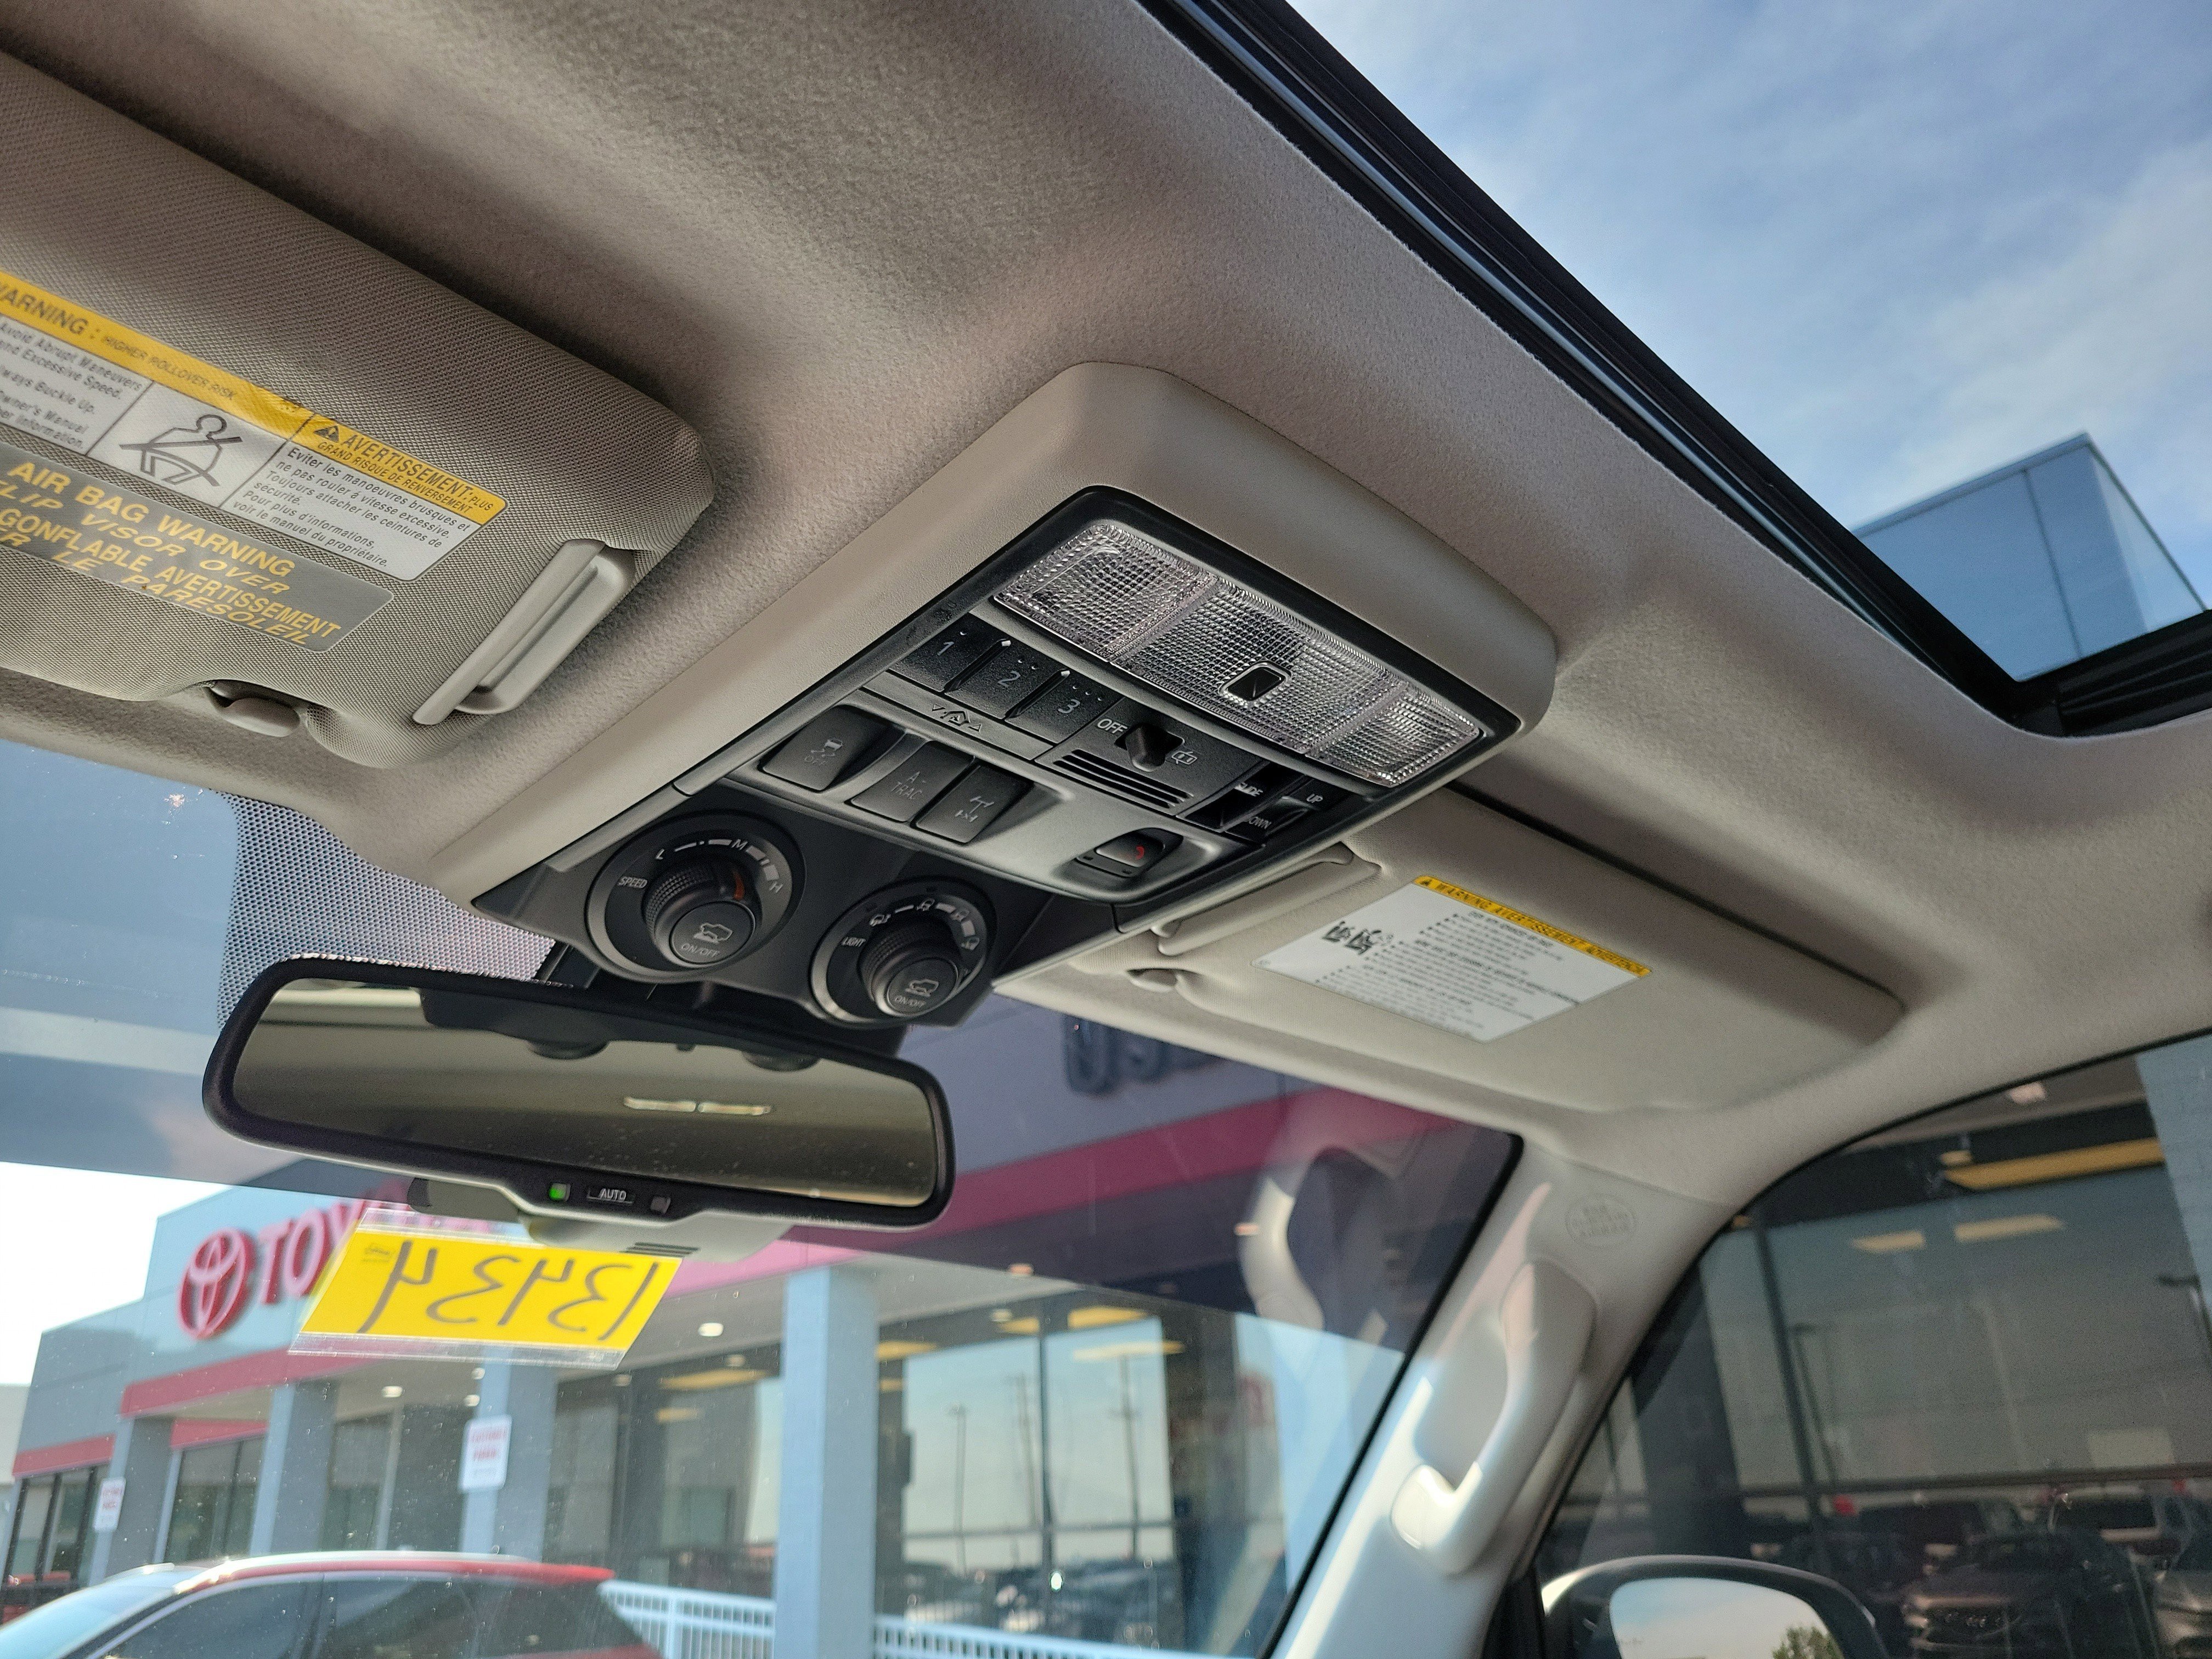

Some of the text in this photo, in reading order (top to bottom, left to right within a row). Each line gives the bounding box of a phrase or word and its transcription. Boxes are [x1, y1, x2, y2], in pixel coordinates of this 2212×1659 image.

[102, 336, 148, 361] HIGHER
[148, 356, 209, 387] ROLLOVER
[208, 383, 236, 400] RISK
[318, 441, 473, 514] GRAND RISQUE DE RENVERSEMENT
[253, 482, 302, 505] sécurité.
[276, 461, 292, 472] ne
[291, 469, 315, 482] pas
[316, 478, 352, 496] rouler
[361, 495, 399, 515] vitesse
[399, 511, 450, 539] excessive.
[288, 447, 471, 532] Eviter les manoeuvres brusques et
[266, 470, 443, 548] Toujours attacher les ceintures de
[469, 496, 494, 511] PLUS
[7, 462, 296, 578] AIR BAG WARNING
[233, 501, 257, 514] voir
[256, 509, 269, 520] le
[269, 516, 312, 536] manuel
[311, 532, 326, 542] du
[243, 490, 375, 549] Pour plus d'informations,
[81, 514, 187, 557] VISOR
[199, 559, 291, 594] OVER
[52, 551, 311, 645] LE PARESOLEIL
[154, 566, 342, 639] AVERTISSEMENT
[936, 641, 955, 657] 1
[997, 670, 1022, 688] 2
[1058, 698, 1081, 715] 3
[1097, 718, 1128, 735] OFF
[890, 781, 923, 800] TRAC
[1306, 793, 1324, 804] UP
[731, 838, 748, 851] M
[618, 876, 648, 889] SPEED
[680, 943, 720, 957] ON/OFF
[842, 936, 866, 947] LIGHT
[598, 1188, 627, 1200] AUTO
